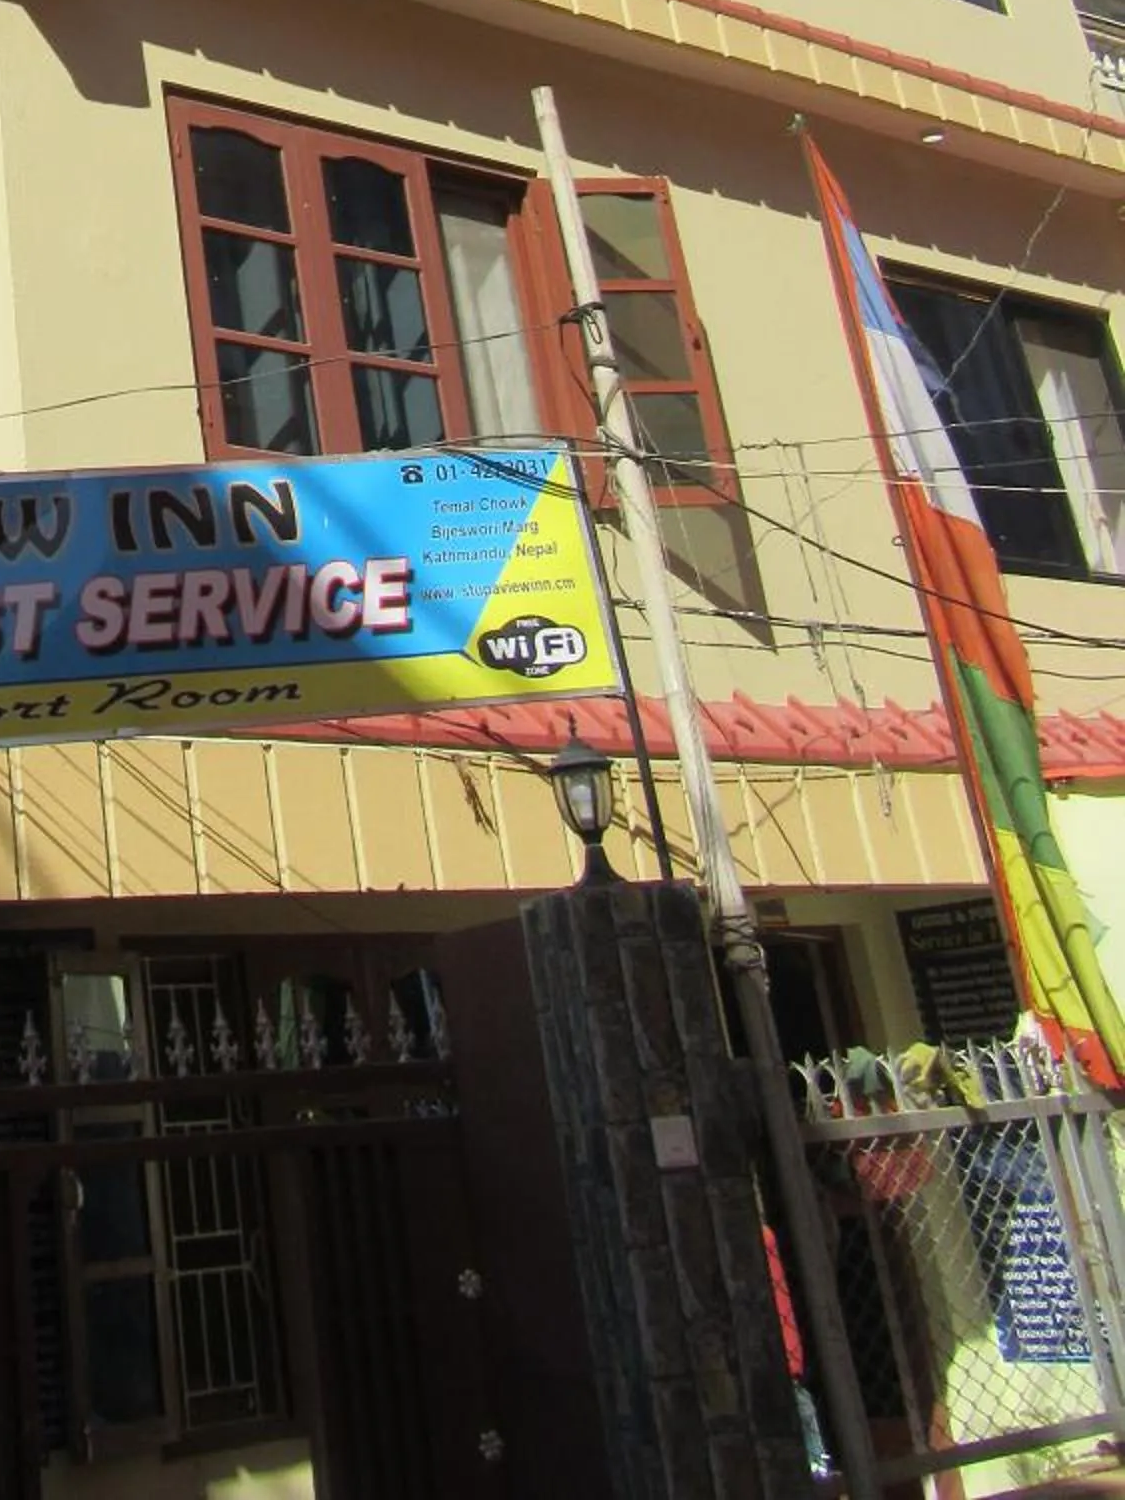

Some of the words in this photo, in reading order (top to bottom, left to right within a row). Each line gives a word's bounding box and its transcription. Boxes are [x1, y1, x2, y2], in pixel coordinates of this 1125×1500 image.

[109, 477, 303, 553] INN
[479, 496, 529, 511] Chowk
[516, 541, 559, 559] Nepal
[75, 556, 414, 657] SERVICE
[94, 679, 302, 714] Room
